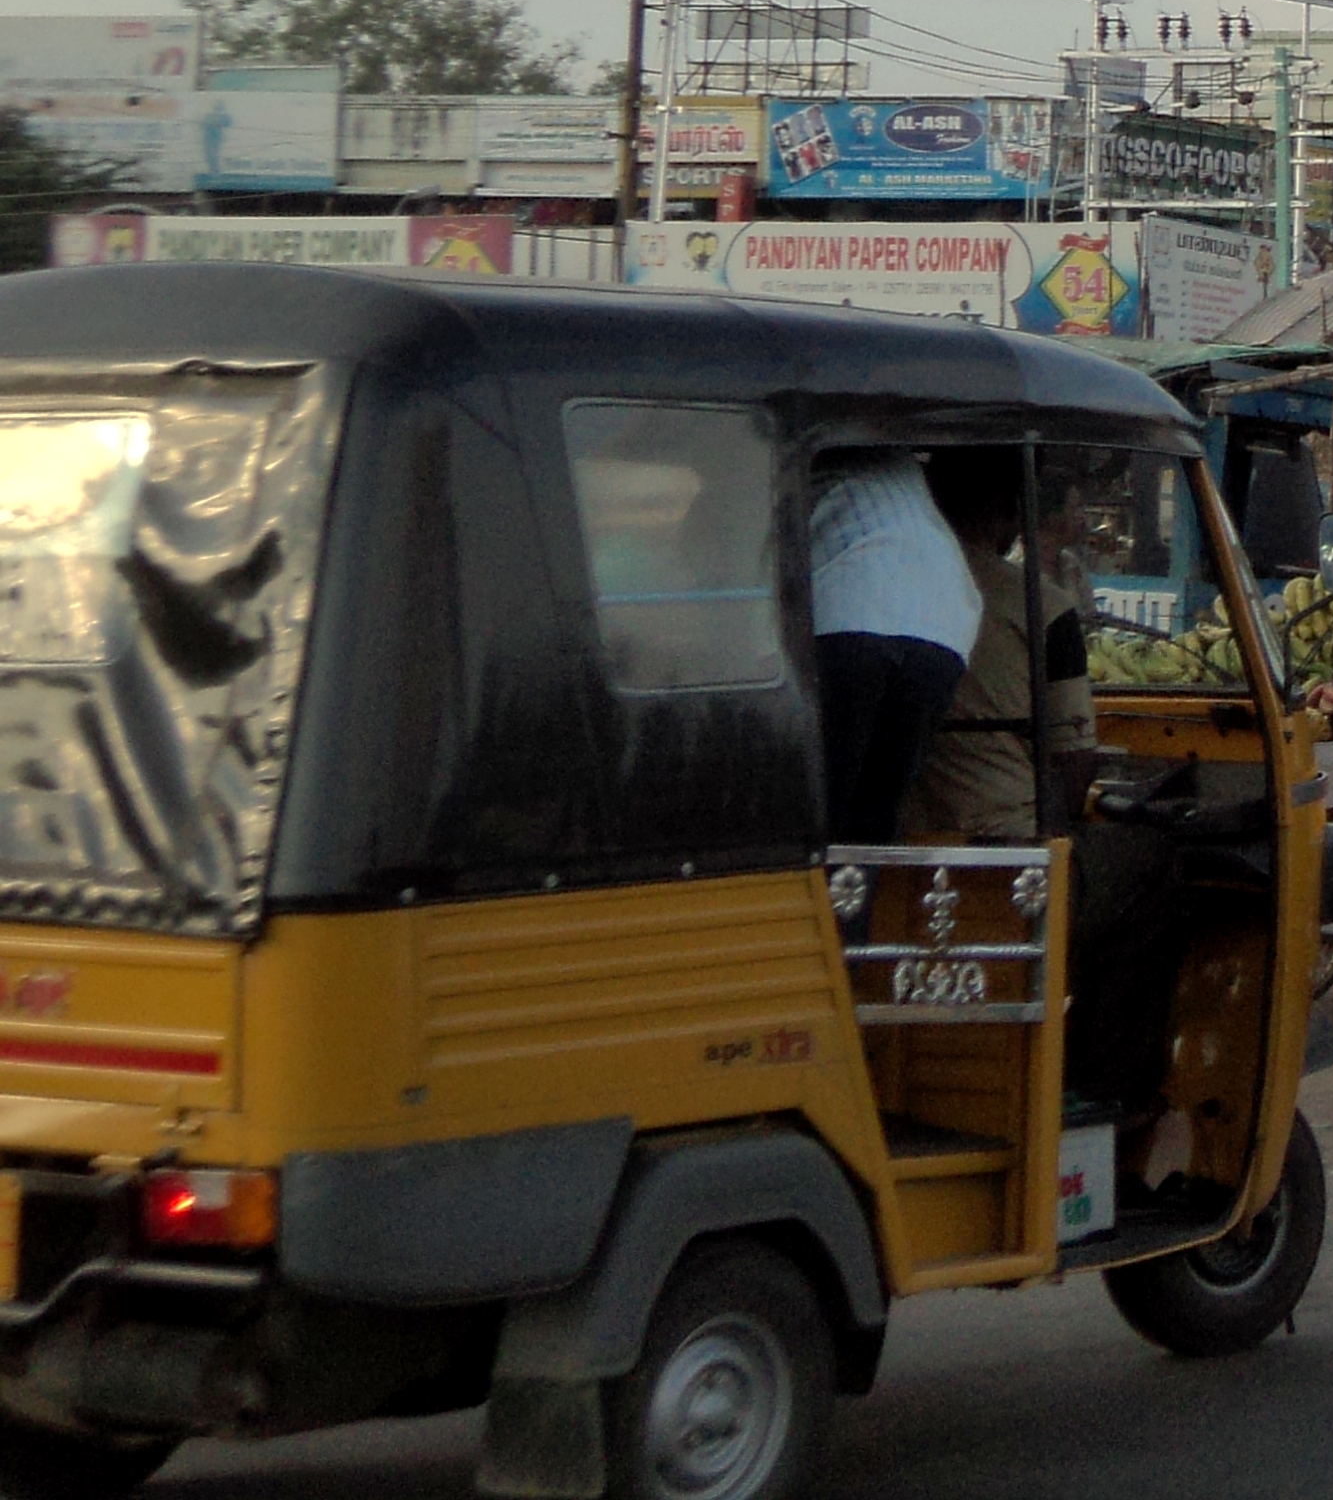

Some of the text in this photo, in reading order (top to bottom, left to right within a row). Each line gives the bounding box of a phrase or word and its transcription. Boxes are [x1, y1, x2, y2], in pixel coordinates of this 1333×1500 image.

[892, 116, 961, 131] AL-ASH
[745, 235, 1012, 274] PANDIYAN PAPER COMPANY
[1062, 265, 1105, 303] 54
